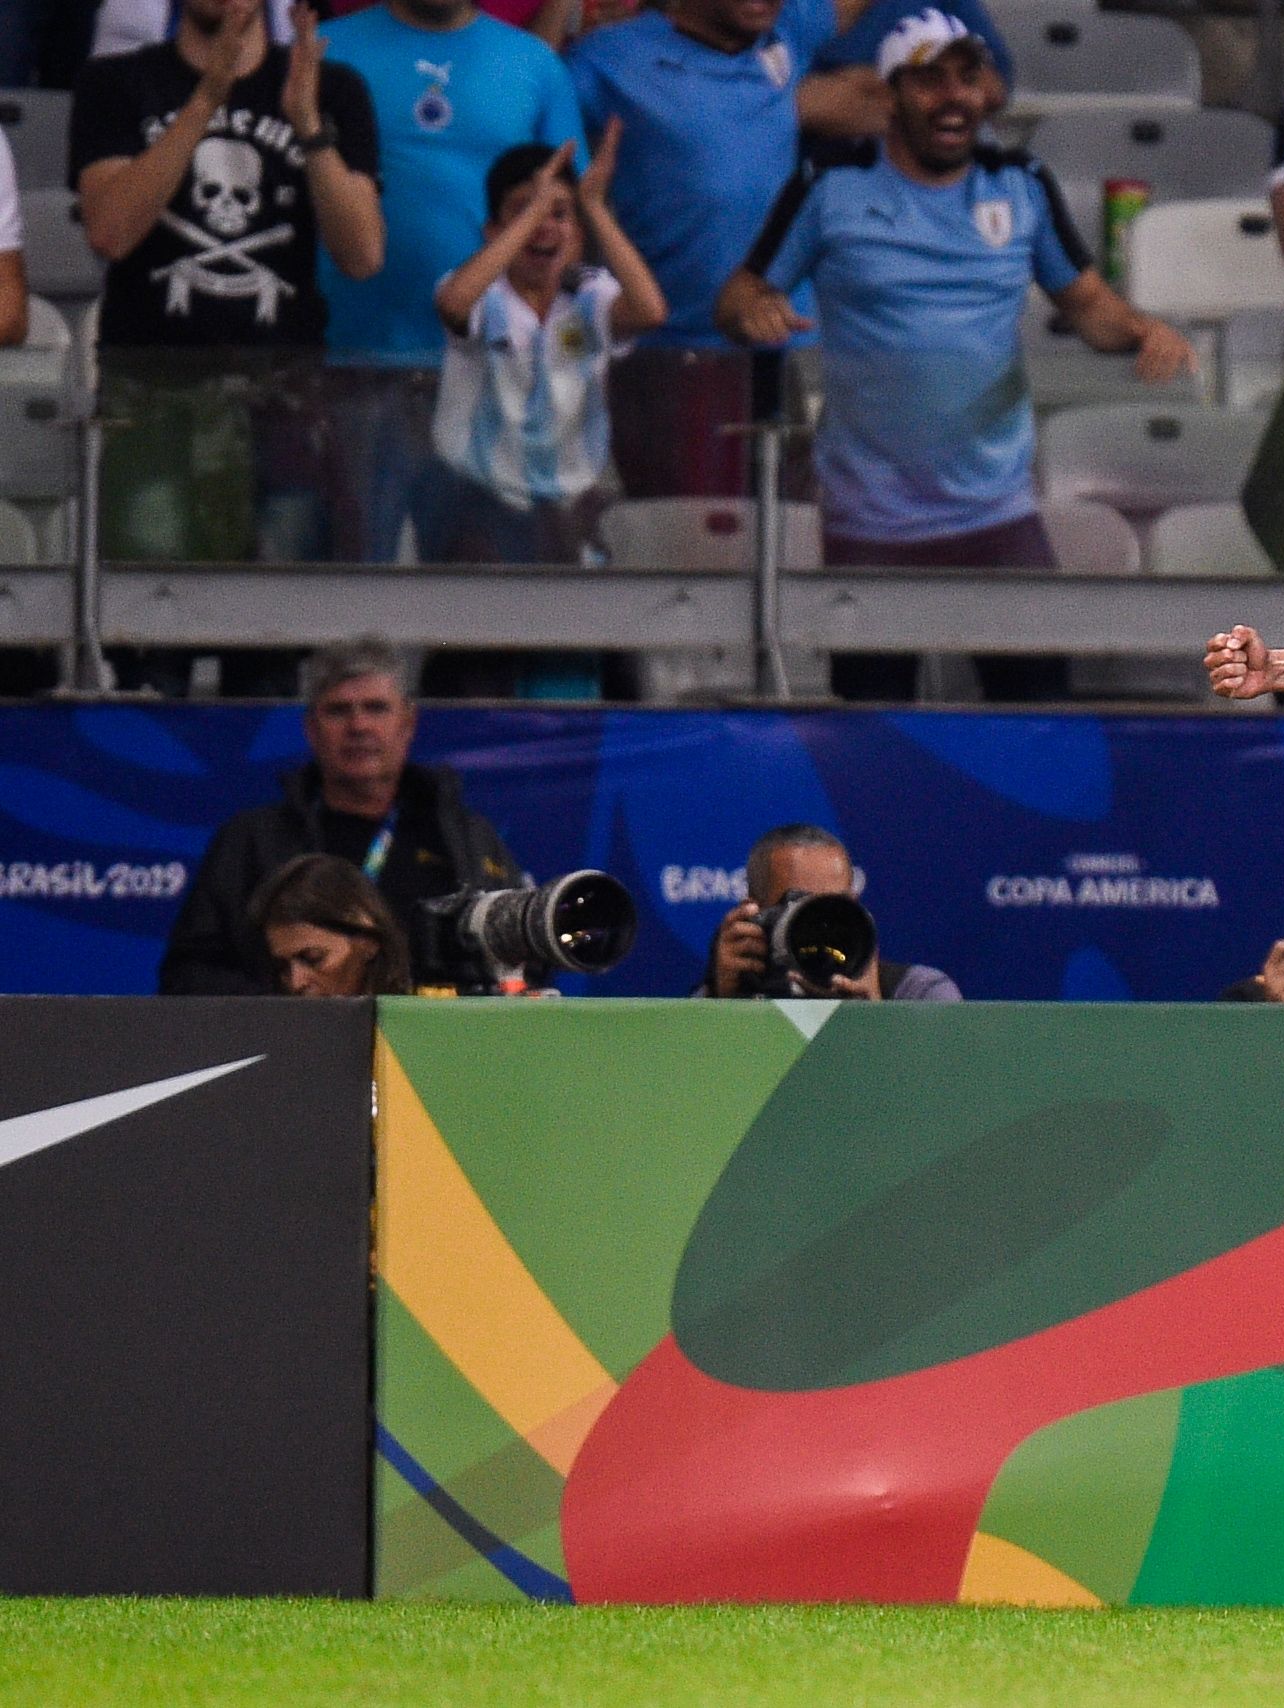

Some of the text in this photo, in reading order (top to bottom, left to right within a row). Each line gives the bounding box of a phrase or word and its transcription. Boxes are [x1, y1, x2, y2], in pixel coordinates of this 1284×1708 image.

[105, 861, 187, 898] 2019
[661, 864, 748, 903] BRAS
[986, 876, 1220, 907] COPA AMERICA
